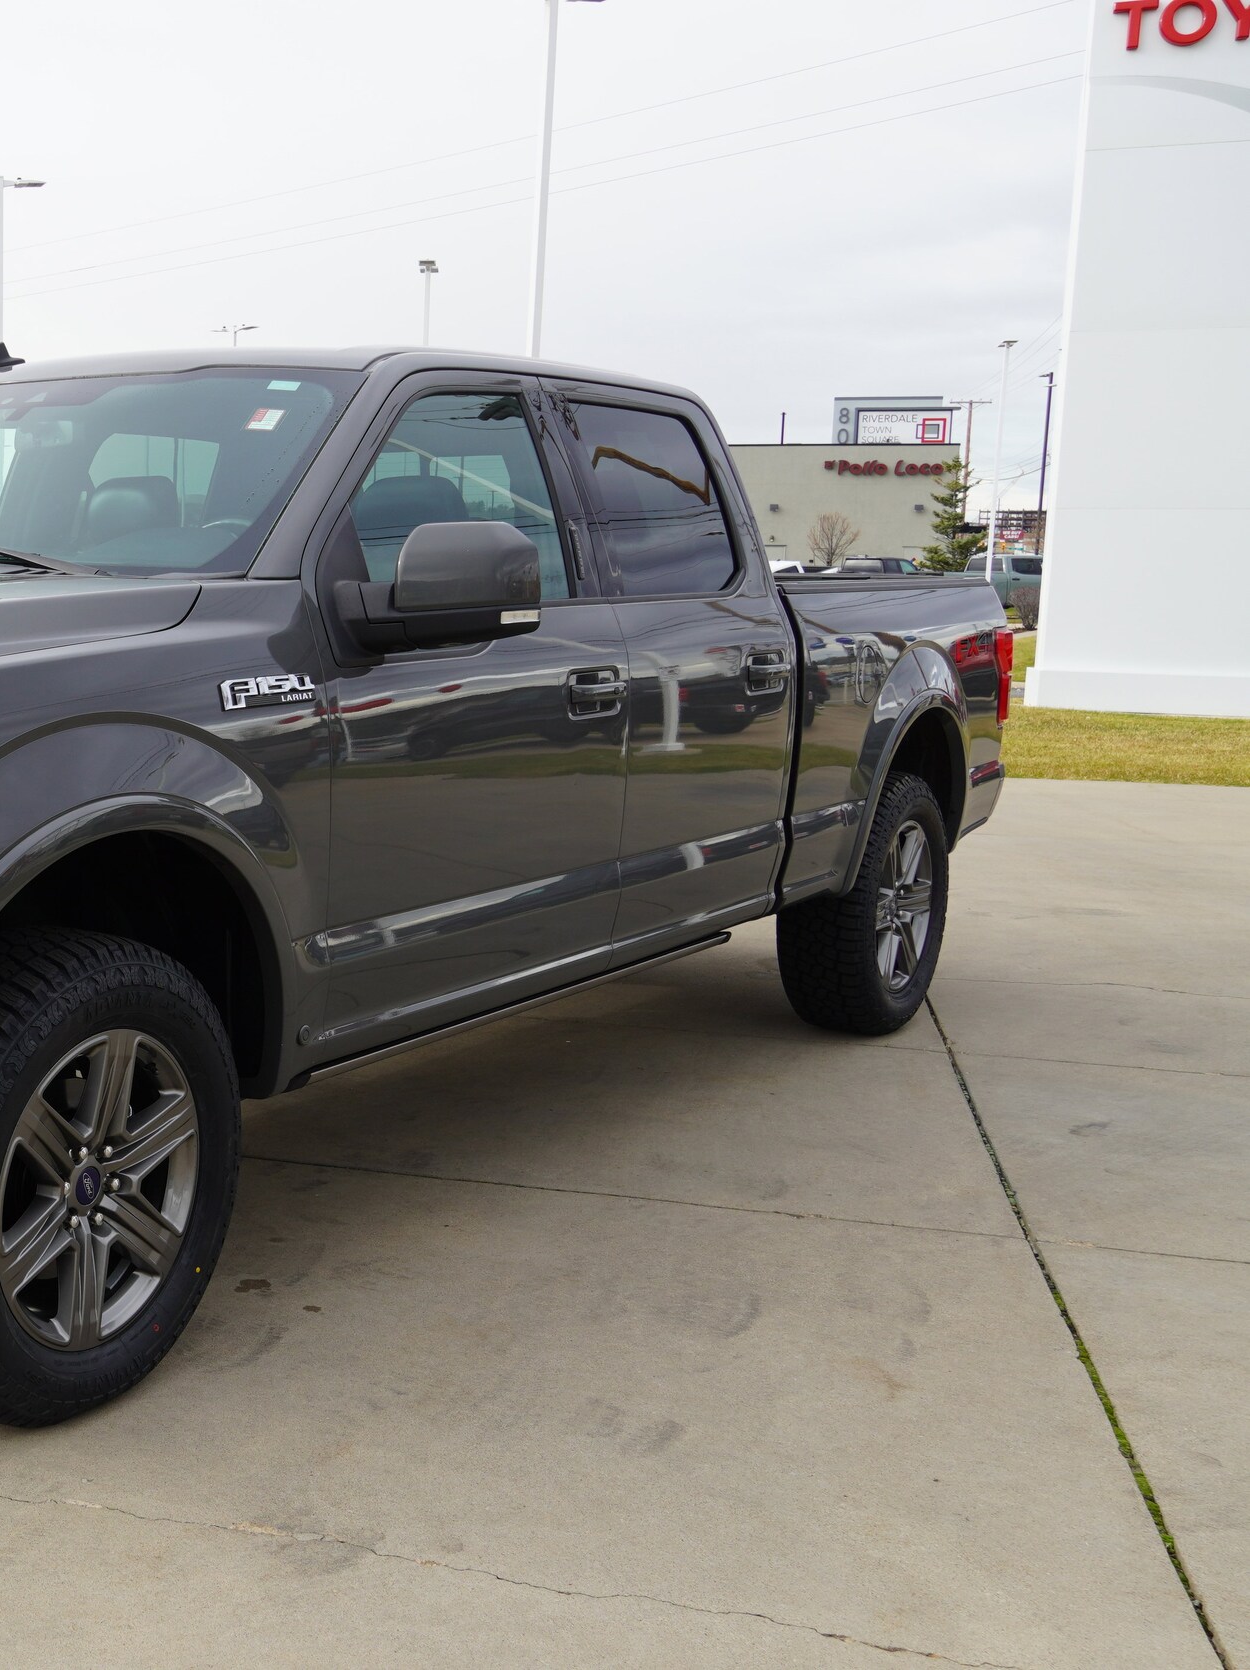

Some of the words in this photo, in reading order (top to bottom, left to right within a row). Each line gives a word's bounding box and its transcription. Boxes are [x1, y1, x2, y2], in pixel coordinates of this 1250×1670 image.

[862, 414, 918, 423] RIVERDALE
[861, 436, 900, 444] SQUARE
[838, 460, 888, 476] Pollo
[894, 460, 944, 476] Loco
[955, 631, 992, 663] FX4
[281, 691, 313, 702] LARIAT
